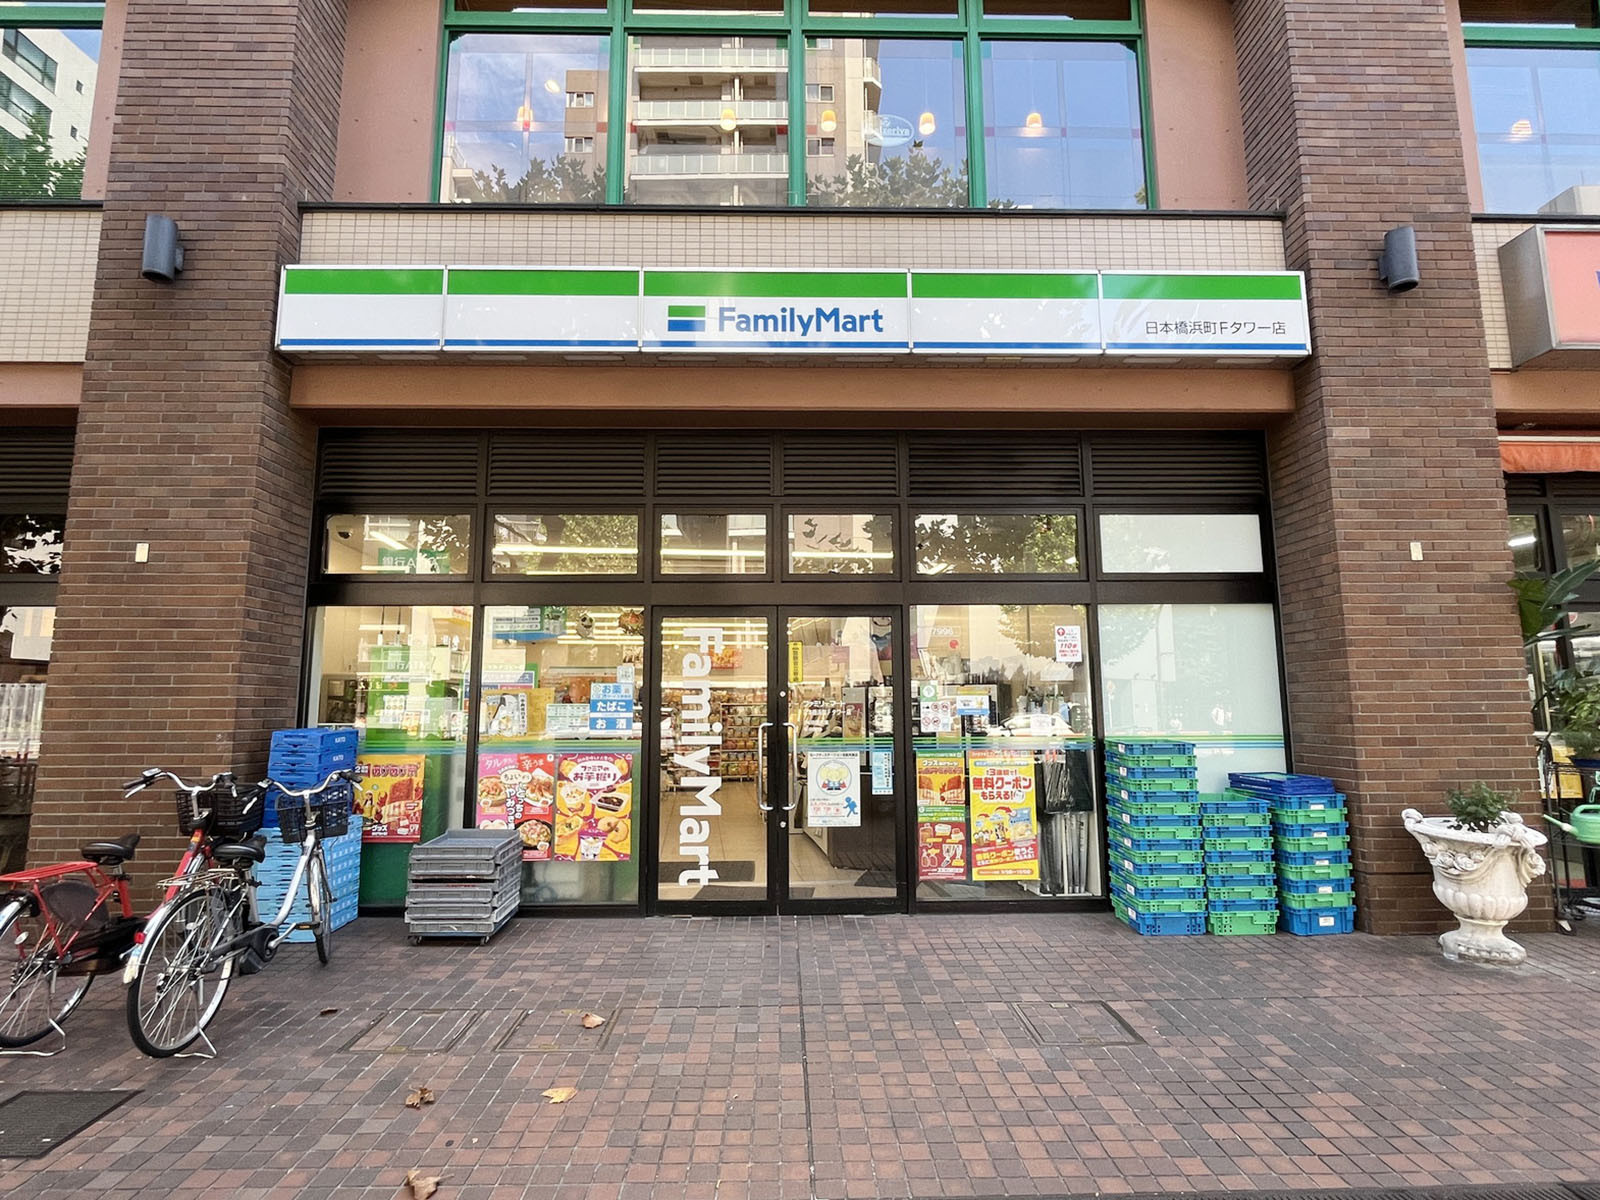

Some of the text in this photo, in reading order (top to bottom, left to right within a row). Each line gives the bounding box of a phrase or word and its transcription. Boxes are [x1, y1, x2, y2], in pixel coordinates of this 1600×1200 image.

[718, 307, 884, 336] FamilyMart
[1145, 321, 1286, 335] 日本橋浜町Fタワー店
[596, 701, 627, 712] たばこ
[674, 627, 723, 887] FamilyMart
[972, 777, 1032, 790] 無料クーポン
